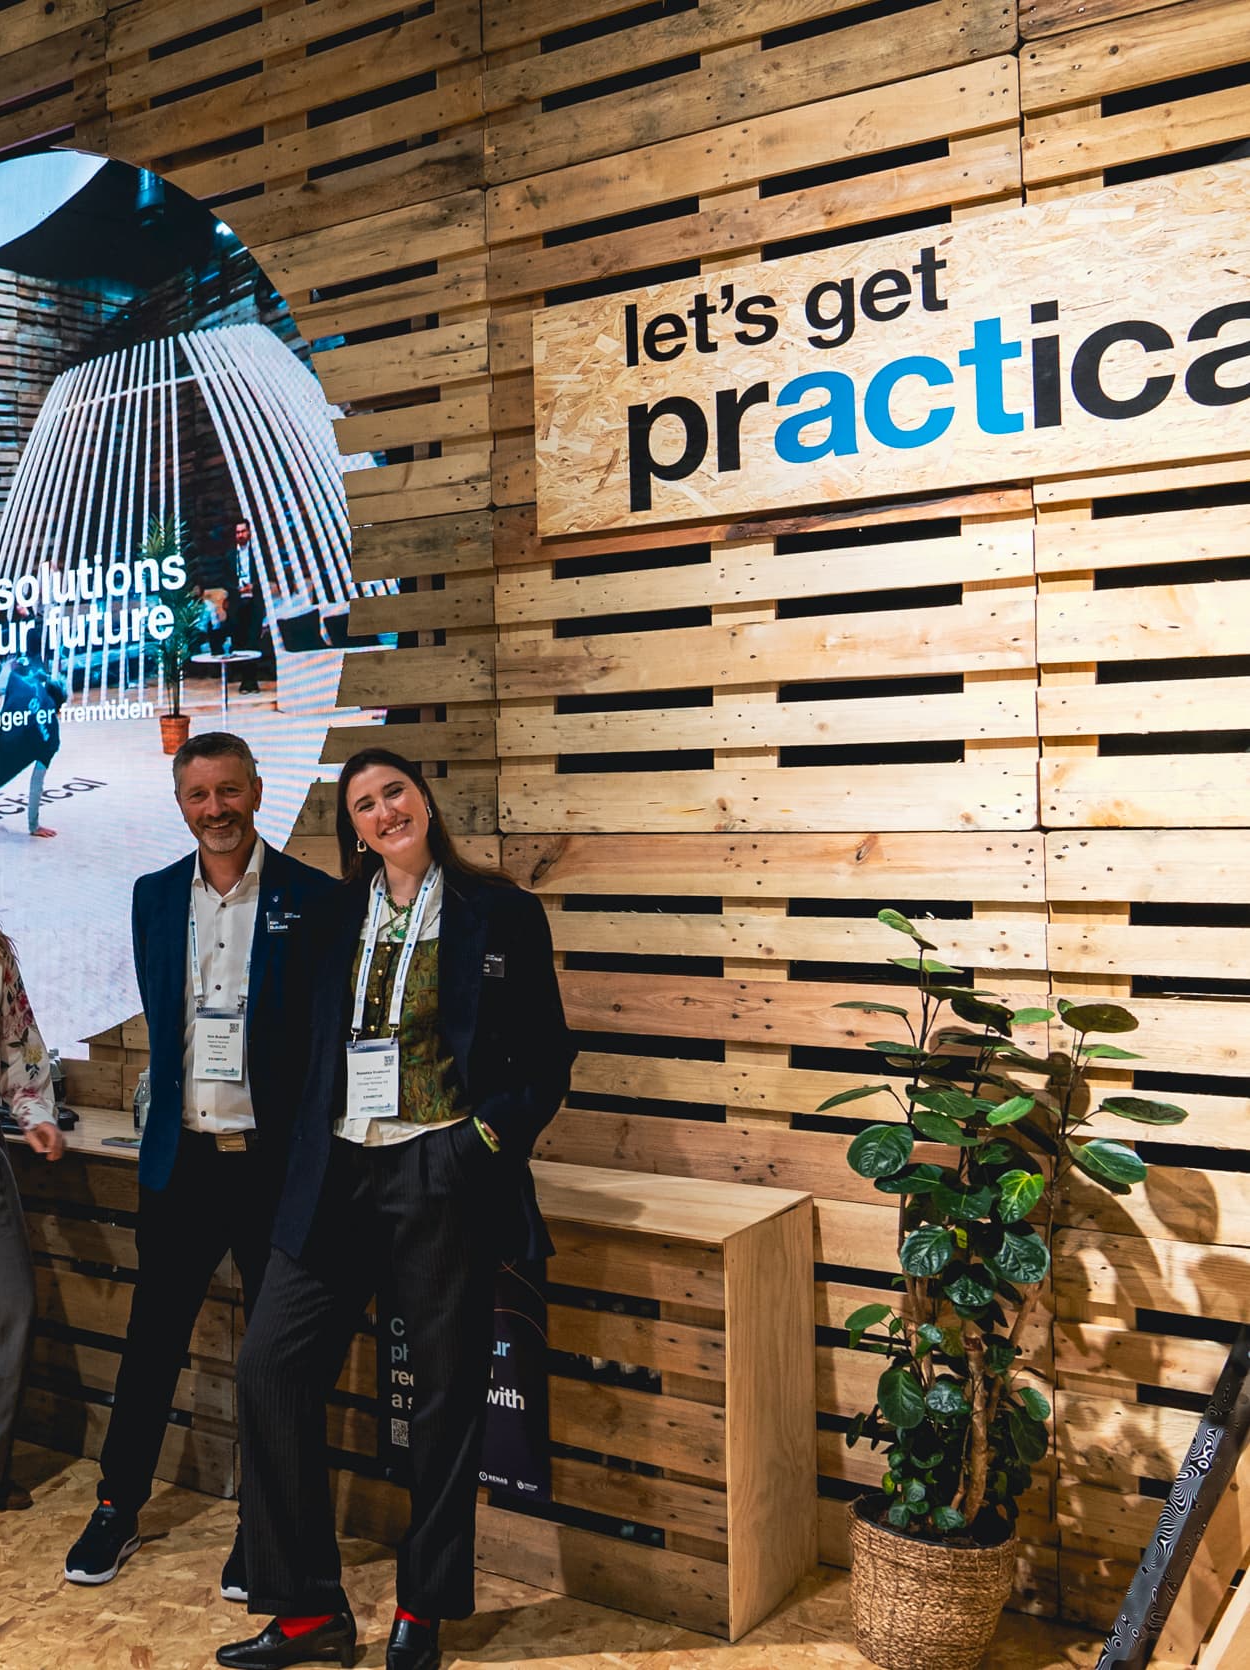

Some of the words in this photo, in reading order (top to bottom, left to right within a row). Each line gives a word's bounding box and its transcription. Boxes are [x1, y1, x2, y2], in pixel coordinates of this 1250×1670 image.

[805, 247, 949, 349] get
[46, 602, 175, 651] future
[36, 708, 55, 725] er
[59, 698, 155, 724] fremtiden
[391, 1393, 403, 1409] a
